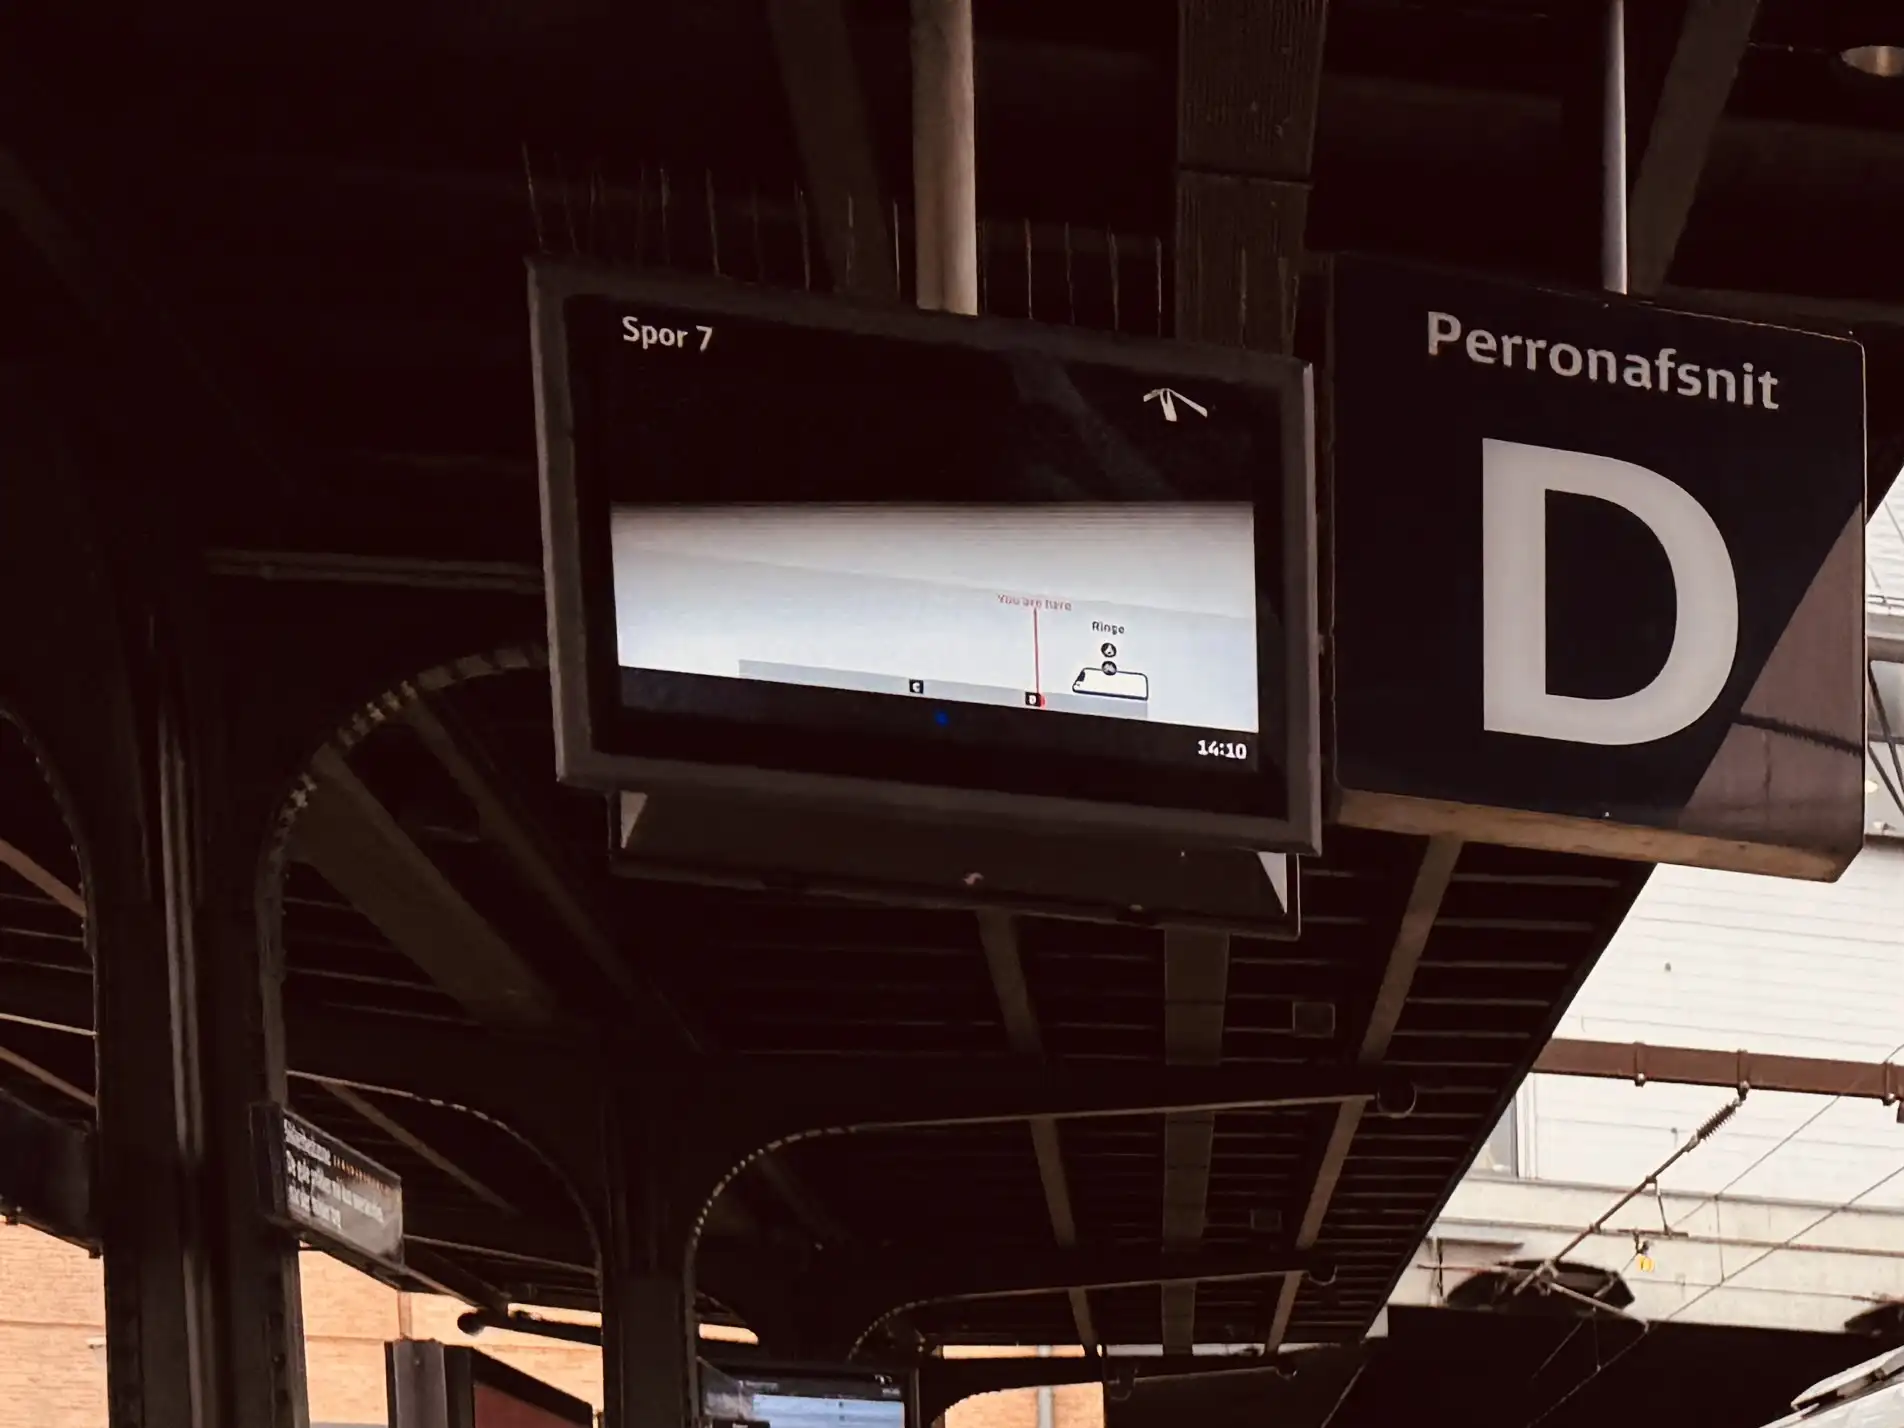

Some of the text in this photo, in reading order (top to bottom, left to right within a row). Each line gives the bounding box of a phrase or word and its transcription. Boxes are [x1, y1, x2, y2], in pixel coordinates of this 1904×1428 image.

[622, 316, 713, 352] Spor 7
[1427, 311, 1780, 410] Perronafsnit
[1482, 437, 1739, 746] D
[1197, 740, 1247, 760] 14:10
